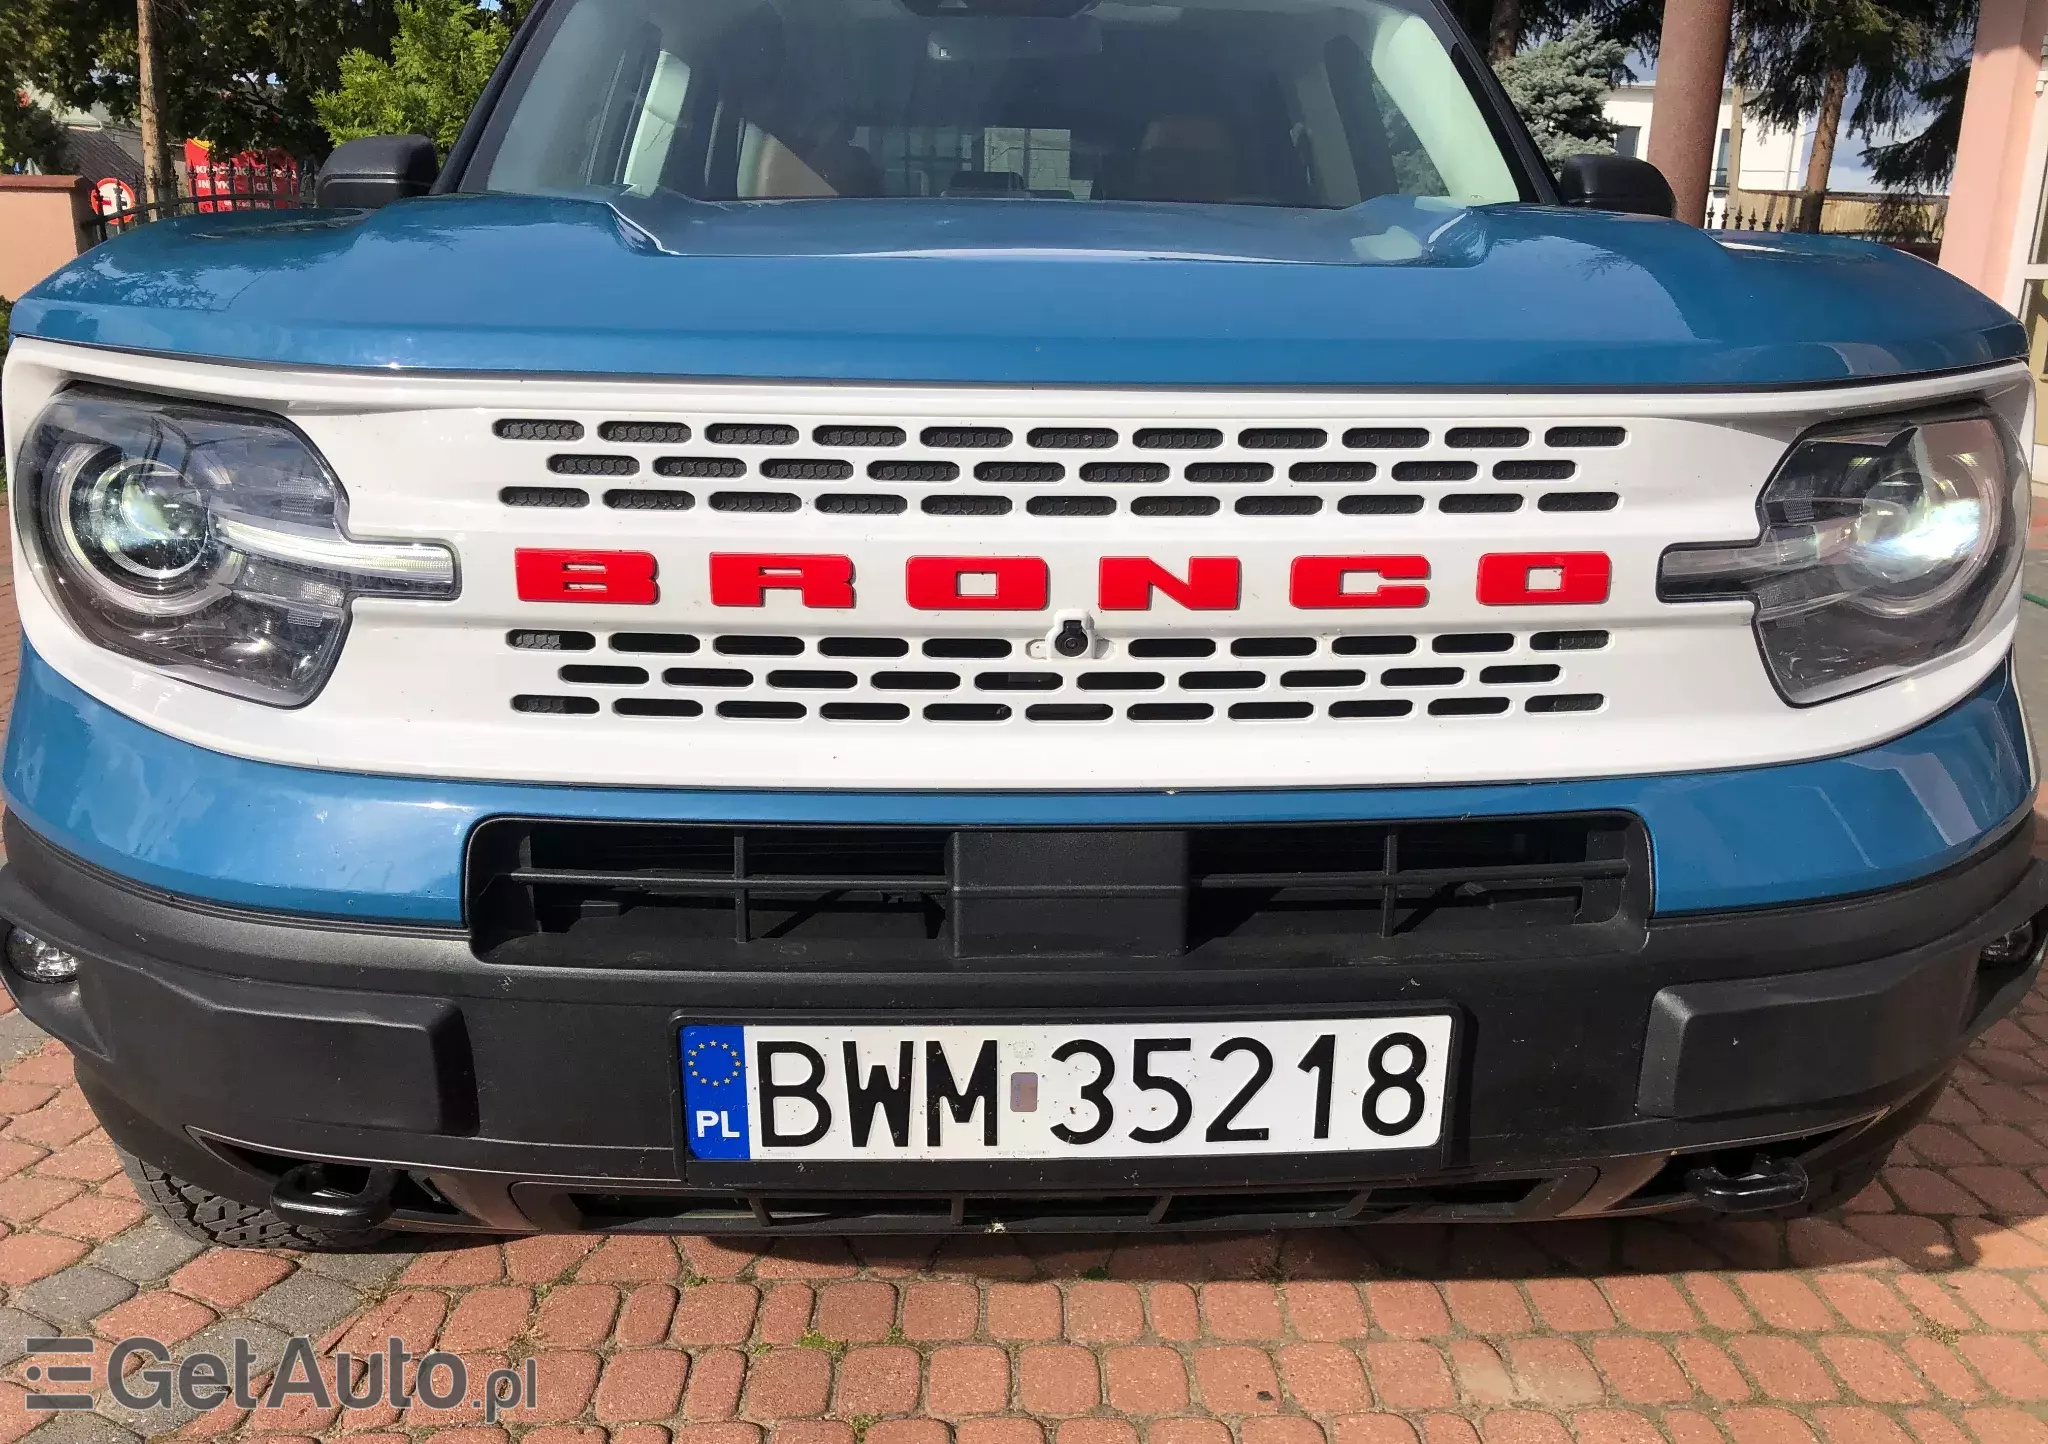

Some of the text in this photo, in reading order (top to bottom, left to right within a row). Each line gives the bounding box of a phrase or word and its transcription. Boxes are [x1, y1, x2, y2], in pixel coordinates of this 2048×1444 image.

[514, 547, 1613, 611] BRONCO
[757, 1033, 1427, 1147] BWM 35218
[696, 1110, 740, 1138] PL
